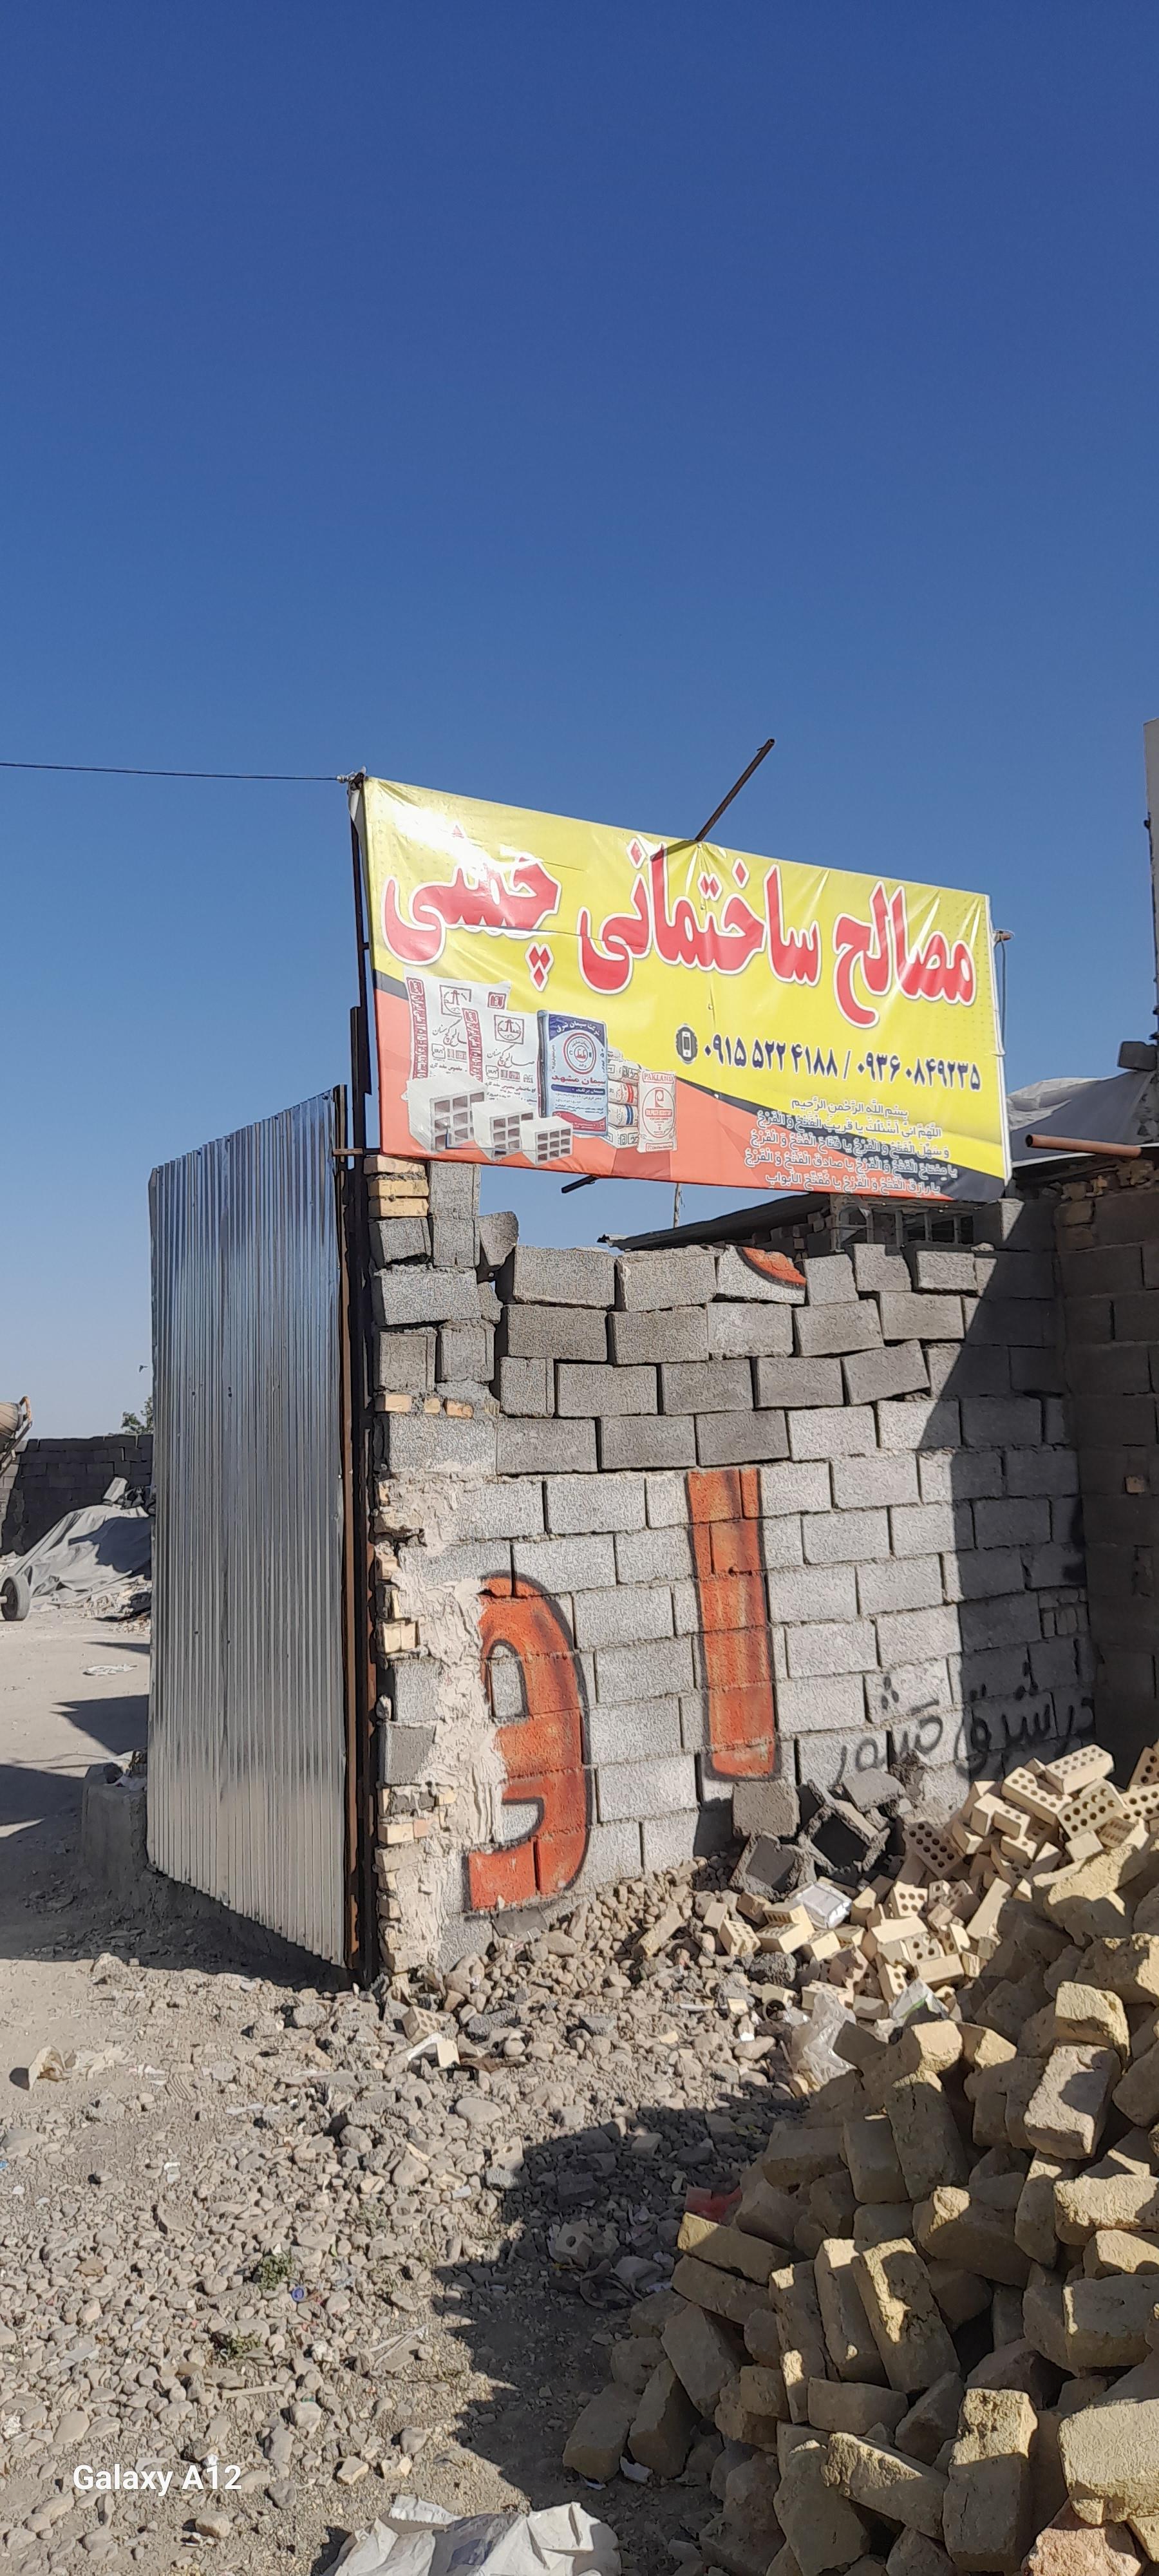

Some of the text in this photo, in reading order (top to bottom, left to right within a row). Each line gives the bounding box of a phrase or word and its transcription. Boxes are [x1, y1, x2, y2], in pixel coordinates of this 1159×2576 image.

[578, 841, 819, 992] ساختمانی
[834, 884, 975, 1027] مصالح
[552, 1075, 607, 1085] سیمان مشهد
[704, 1034, 747, 1068] ۰۹۱۵
[753, 1039, 786, 1070] ۵۲۲
[791, 1043, 838, 1077] ۴۱۸۸
[858, 1052, 900, 1083] ۰۹۳۶
[905, 1059, 981, 1091] ۰۸۴۹۲۳۵
